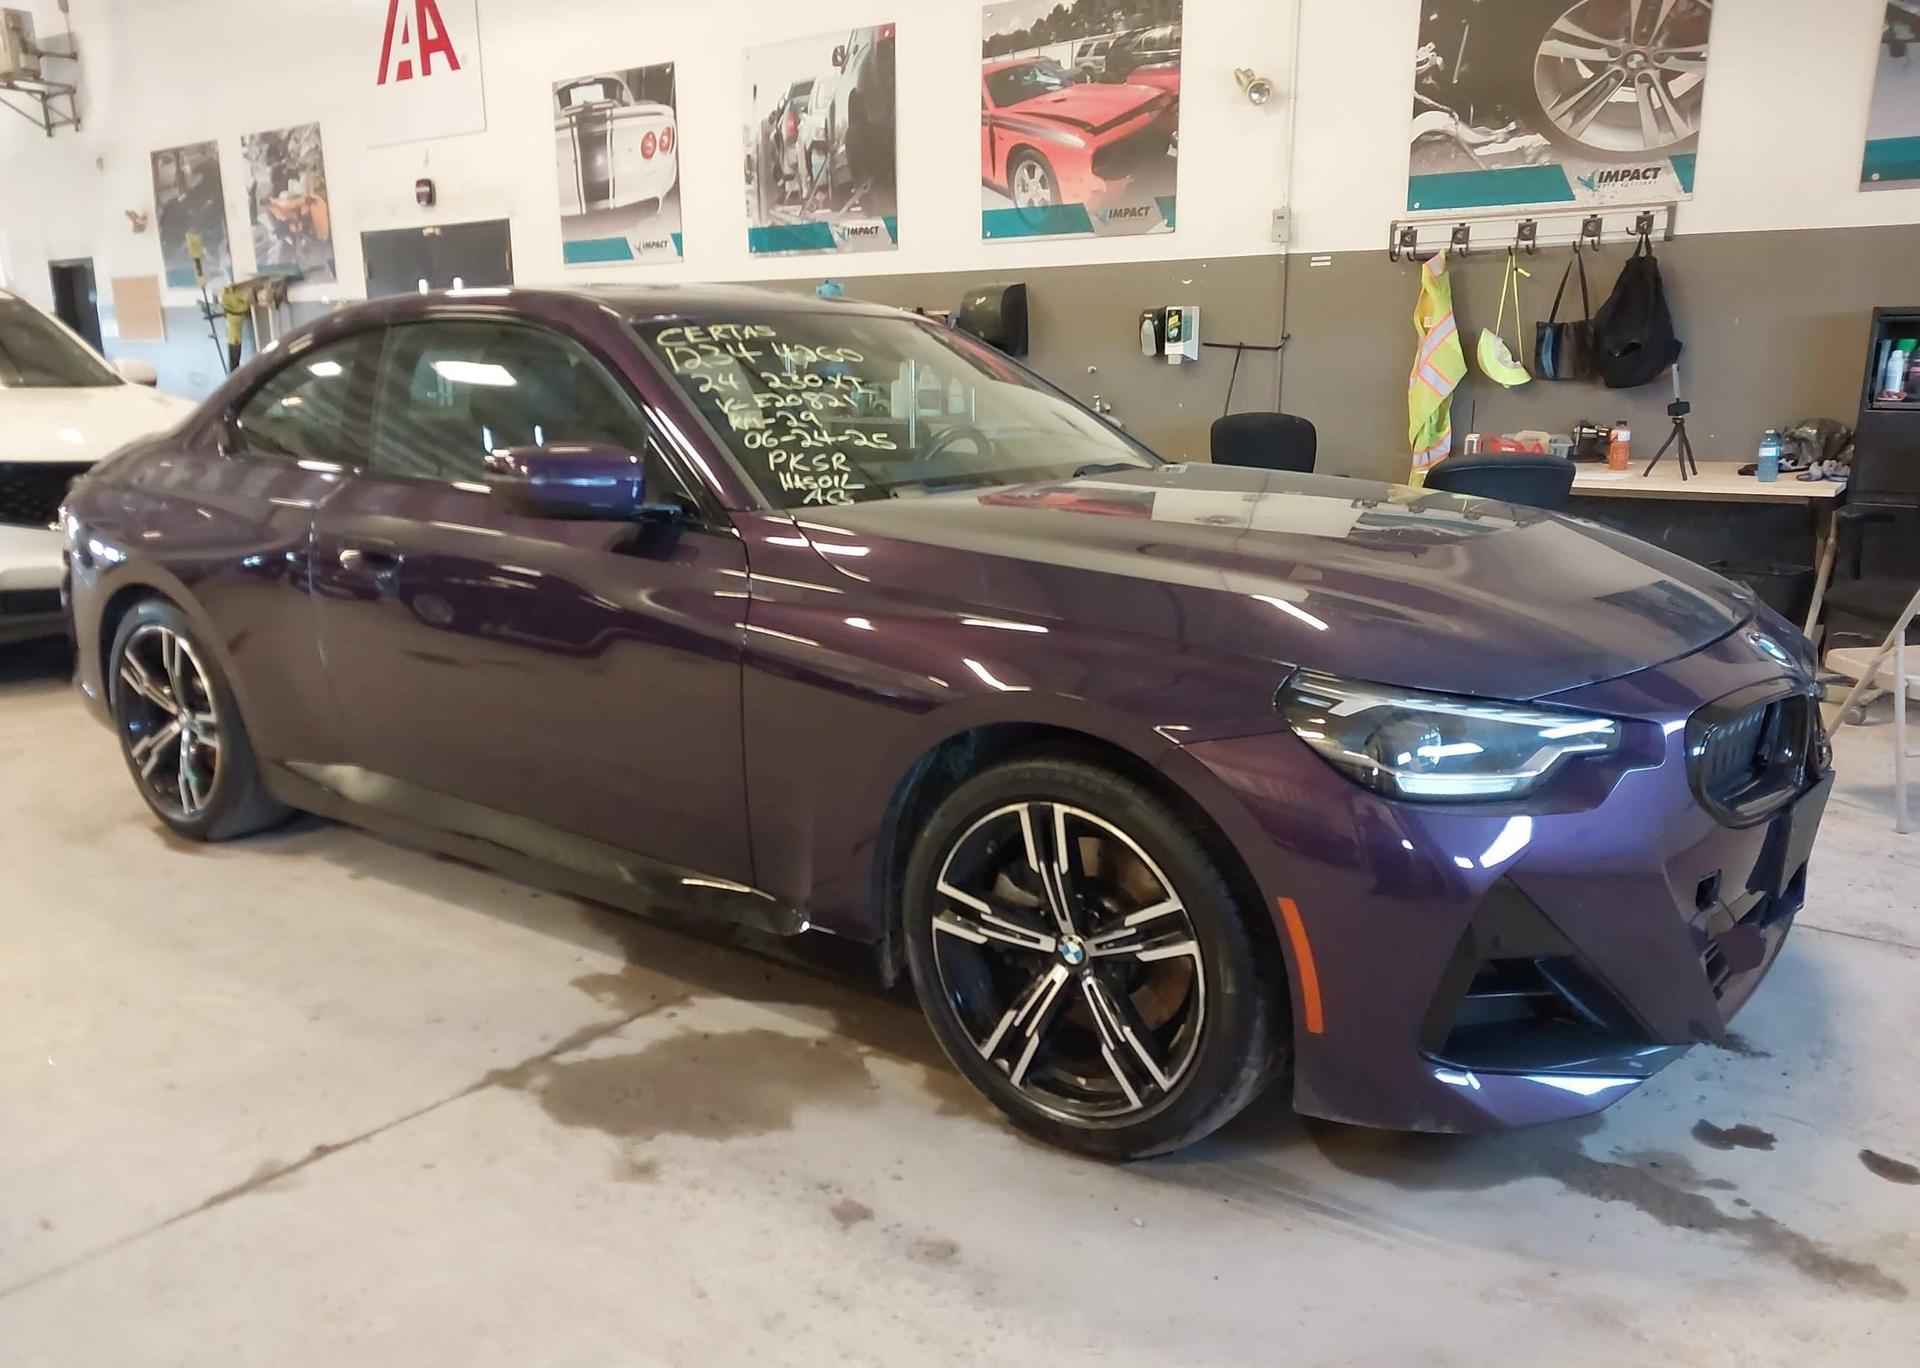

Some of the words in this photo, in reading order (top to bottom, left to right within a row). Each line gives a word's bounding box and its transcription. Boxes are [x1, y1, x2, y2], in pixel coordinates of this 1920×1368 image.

[1598, 166, 1661, 183] IMPACT
[1109, 206, 1151, 219] IMPACT
[847, 226, 879, 236] IMPACT
[642, 240, 668, 249] IMPACT
[656, 324, 776, 346] CERTAS
[690, 373, 739, 393] 24
[744, 429, 897, 450] 06-24-25
